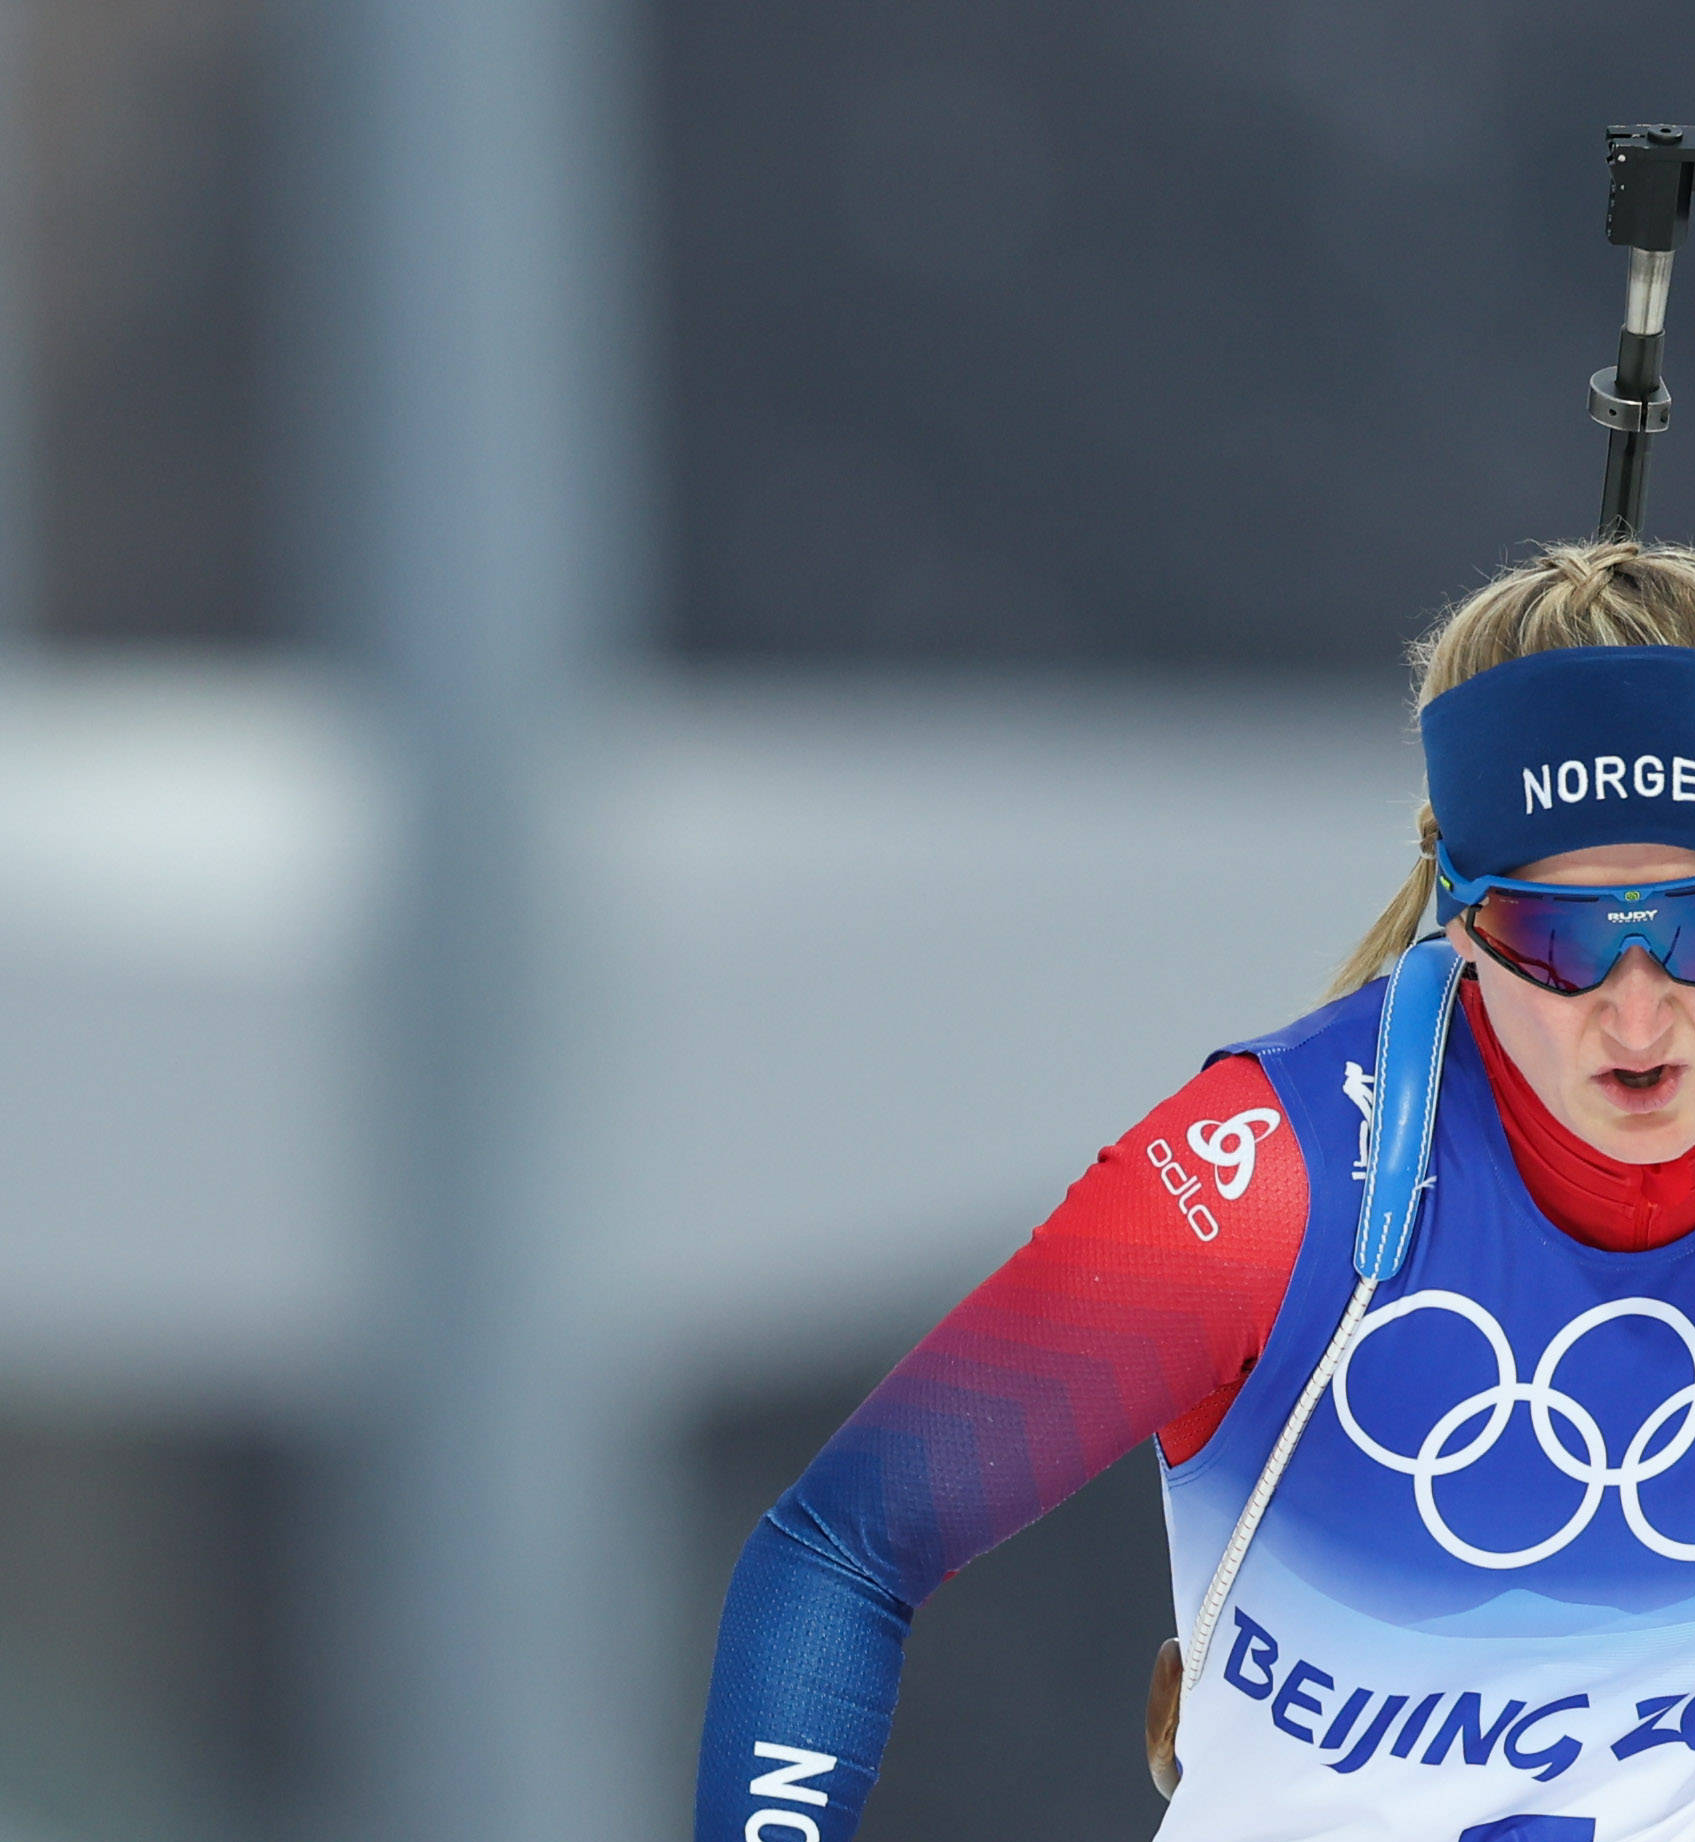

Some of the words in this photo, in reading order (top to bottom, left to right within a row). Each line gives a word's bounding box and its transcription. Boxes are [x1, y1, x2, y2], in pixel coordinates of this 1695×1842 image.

[1607, 909, 1658, 921] RUDY
[1146, 1138, 1220, 1242] odlo
[1222, 1605, 1590, 1782] BEIJING
